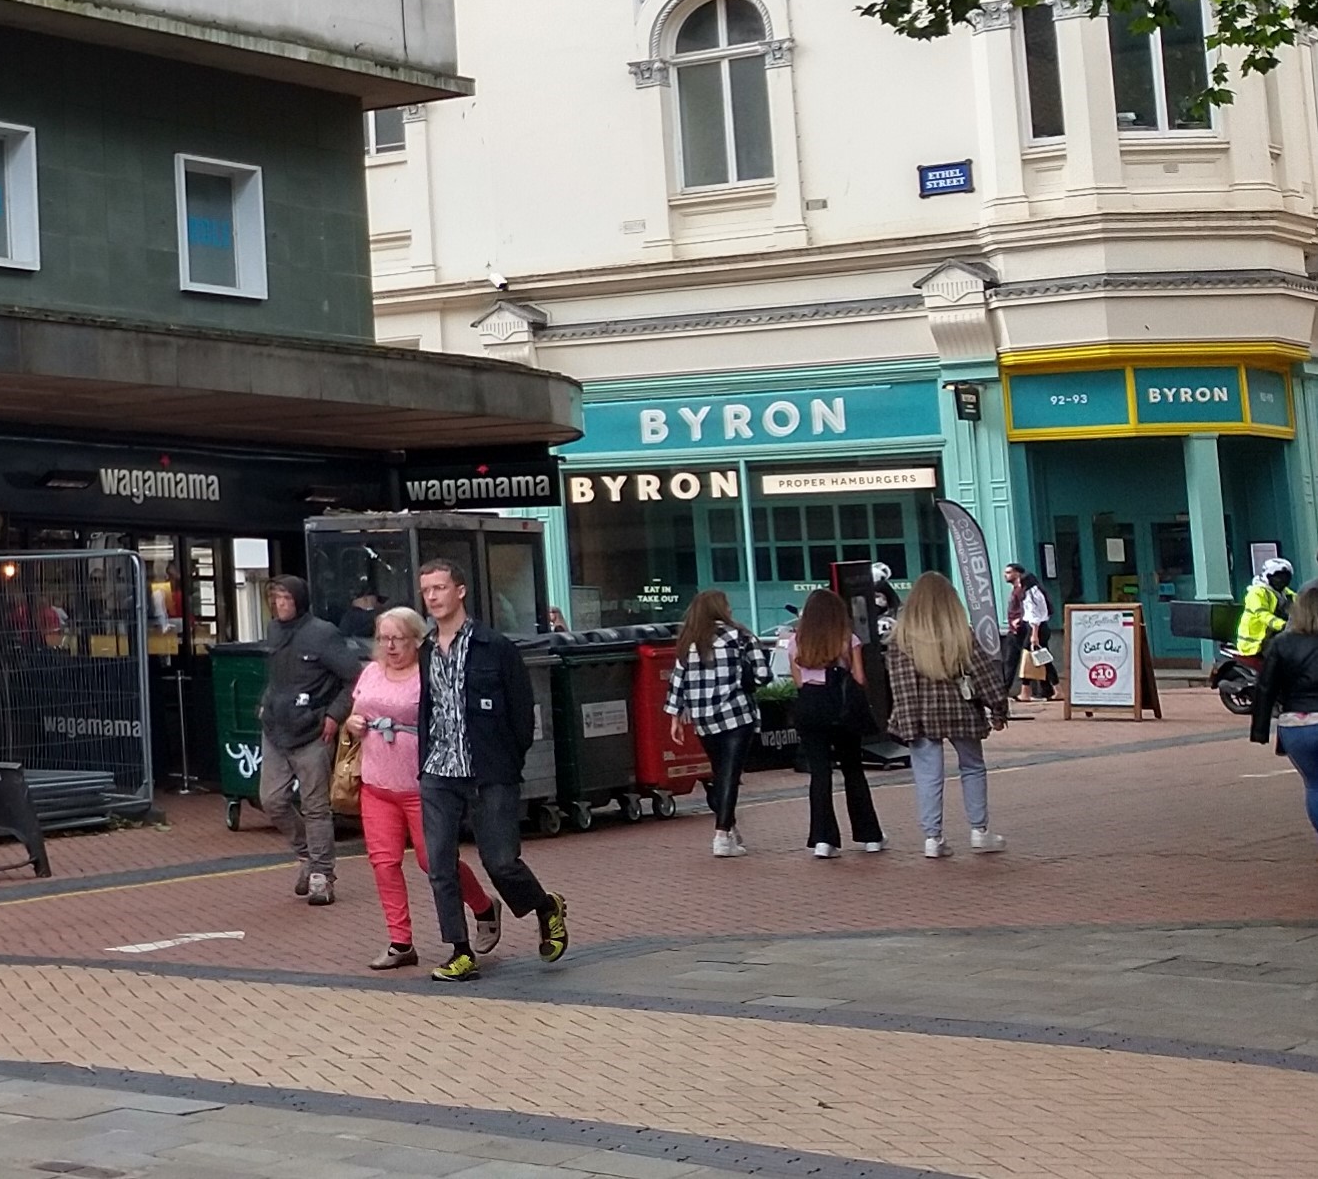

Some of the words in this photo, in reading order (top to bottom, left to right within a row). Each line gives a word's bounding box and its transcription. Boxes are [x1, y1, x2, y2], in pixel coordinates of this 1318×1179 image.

[925, 177, 966, 189] STREET
[928, 169, 963, 180] ETHEL
[1050, 393, 1088, 406] 92-93
[1148, 387, 1229, 404] BYRON
[639, 397, 847, 445] BYRON
[99, 466, 220, 505] wagamama
[406, 473, 550, 506] wagamama
[570, 471, 740, 504] BYRON
[778, 477, 826, 488] PROPER
[831, 474, 917, 486] HAMBURGERS
[1084, 642, 1101, 654] Eat
[1091, 669, 1114, 679] £10
[44, 716, 142, 738] wagamama
[761, 729, 801, 750] wagam
